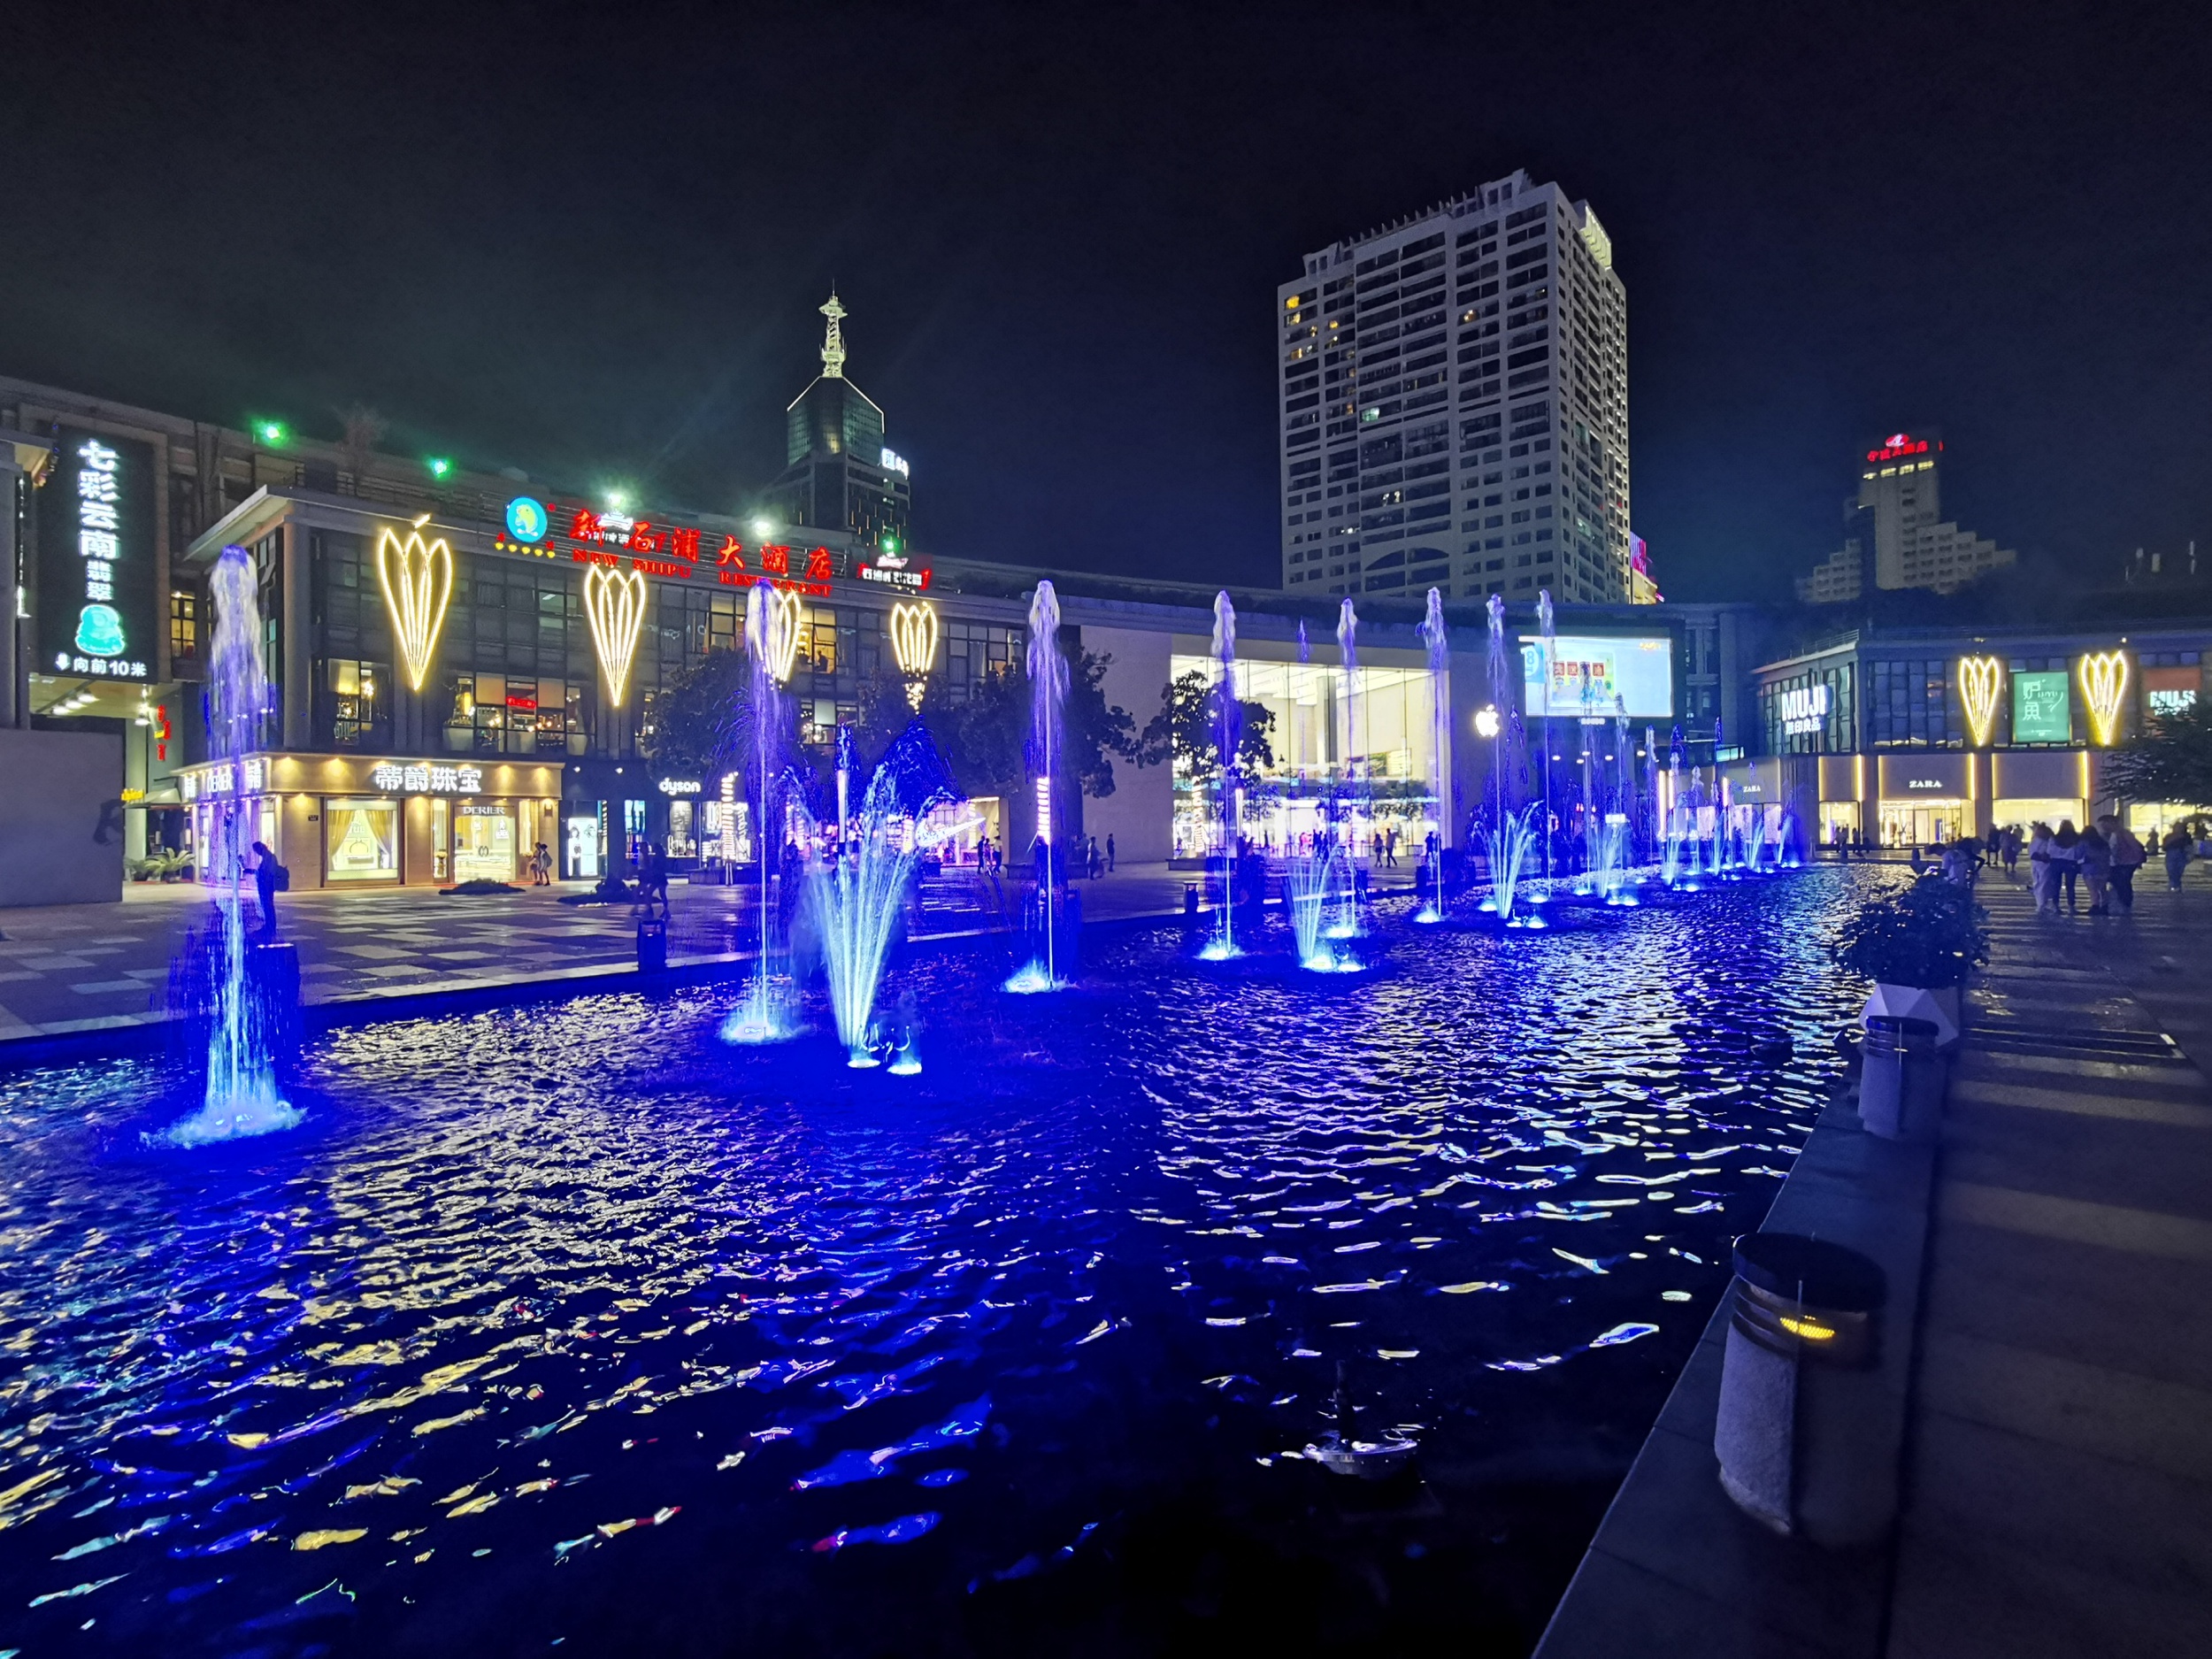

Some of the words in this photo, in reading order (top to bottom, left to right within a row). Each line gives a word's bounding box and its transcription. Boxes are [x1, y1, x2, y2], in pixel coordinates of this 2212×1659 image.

[572, 548, 619, 567] NEW
[632, 557, 692, 579] SHIPU
[718, 571, 833, 597] RESTURANT
[73, 655, 148, 678] 向前10米
[1781, 685, 1826, 721] MUJI
[375, 764, 482, 793] 蒂爵珠宝
[658, 777, 702, 795] dyson
[1909, 780, 1943, 788] ZARA
[463, 805, 505, 815] DERIER
